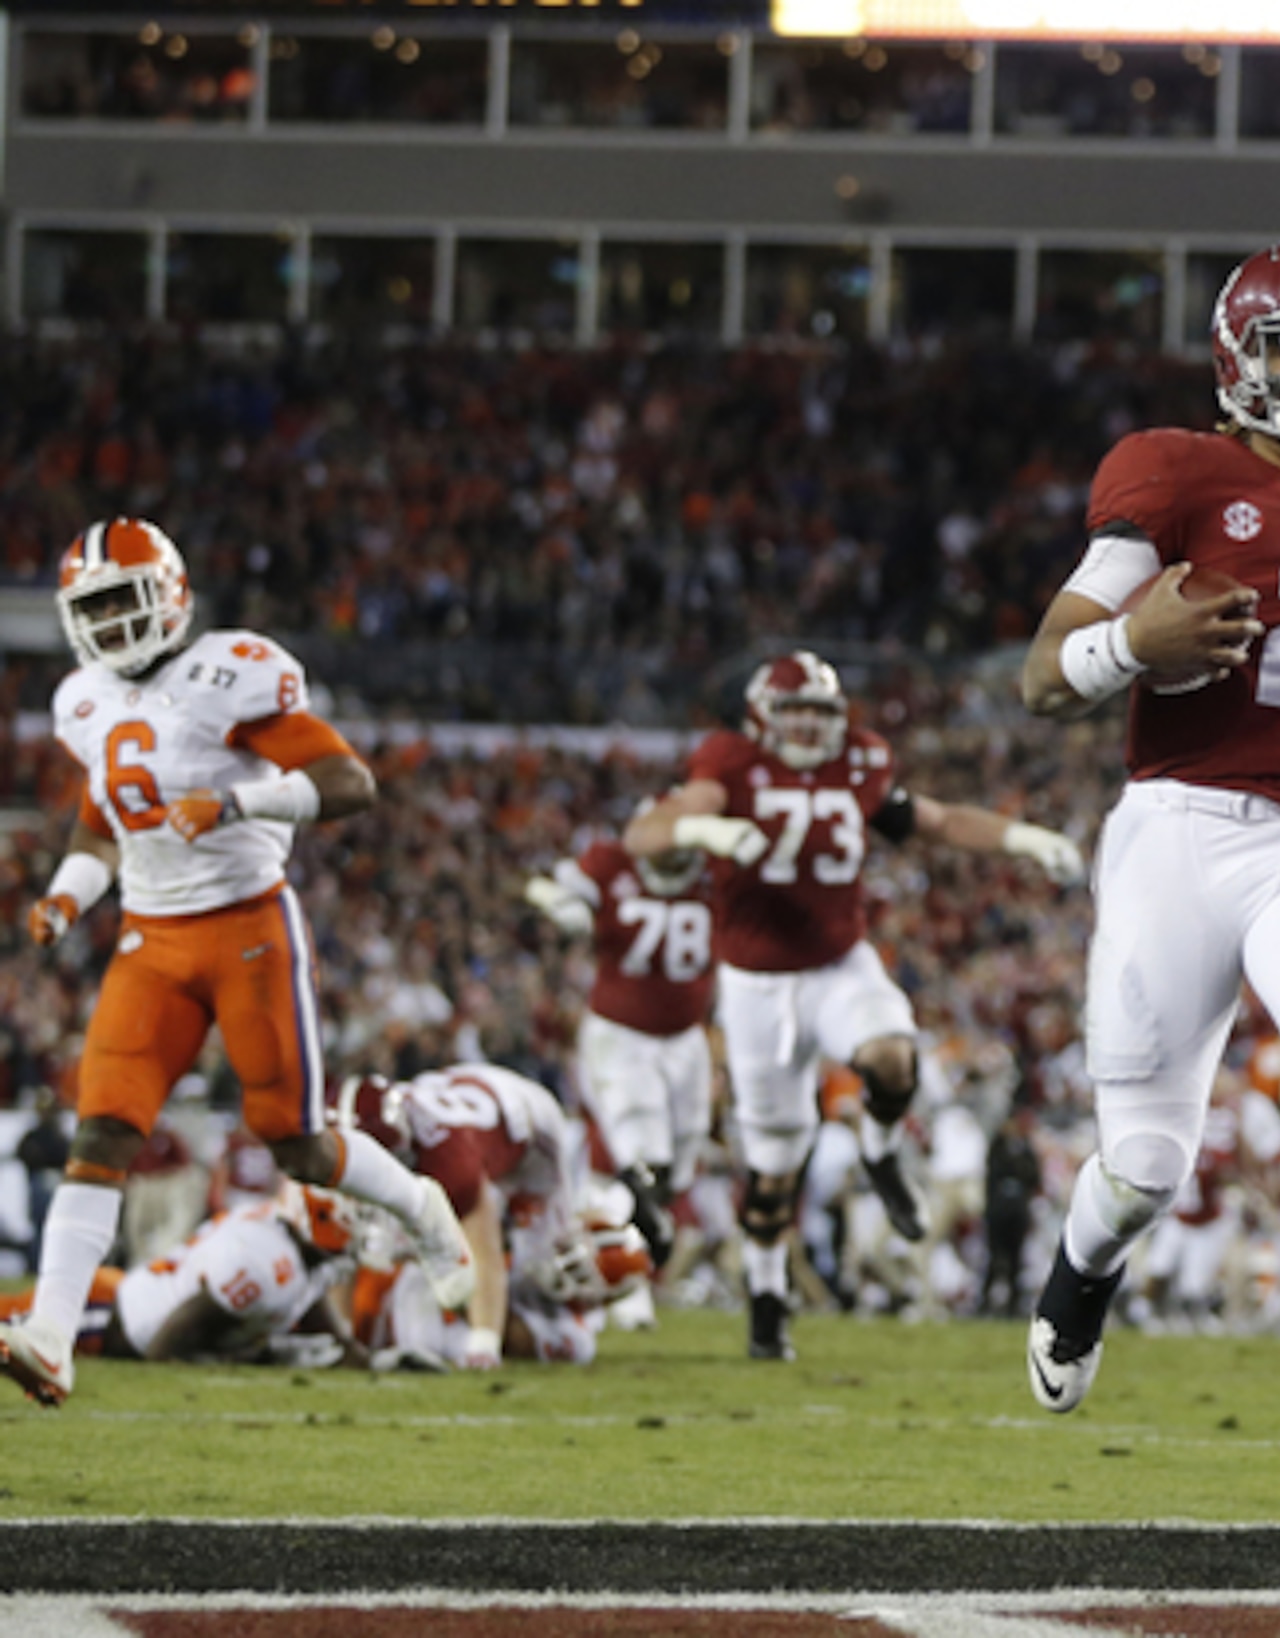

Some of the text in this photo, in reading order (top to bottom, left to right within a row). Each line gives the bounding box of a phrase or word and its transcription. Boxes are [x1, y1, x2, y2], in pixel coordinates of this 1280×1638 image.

[276, 672, 299, 712] 6
[105, 721, 168, 831] 6
[754, 788, 866, 885] 73
[616, 899, 711, 983] 78
